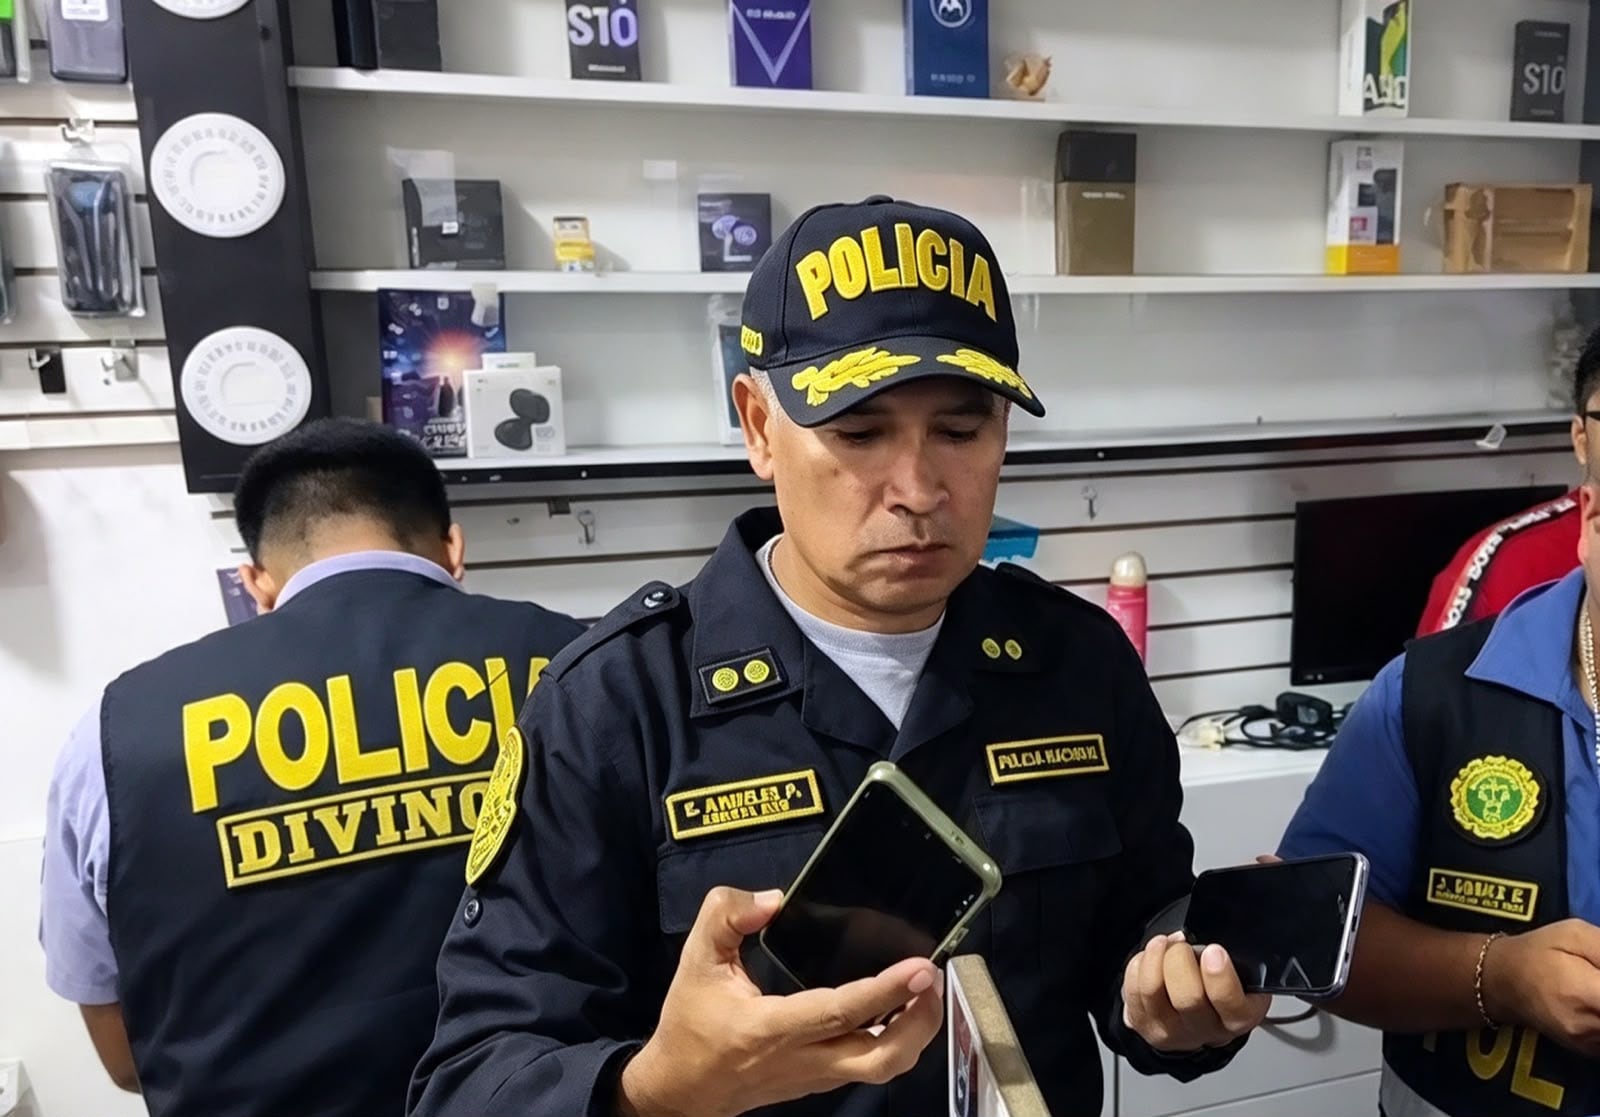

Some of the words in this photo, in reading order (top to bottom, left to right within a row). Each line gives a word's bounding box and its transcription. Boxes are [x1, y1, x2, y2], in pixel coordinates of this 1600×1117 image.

[567, 4, 638, 47] S10
[1523, 62, 1566, 95] S10
[796, 223, 997, 322] POLICIA
